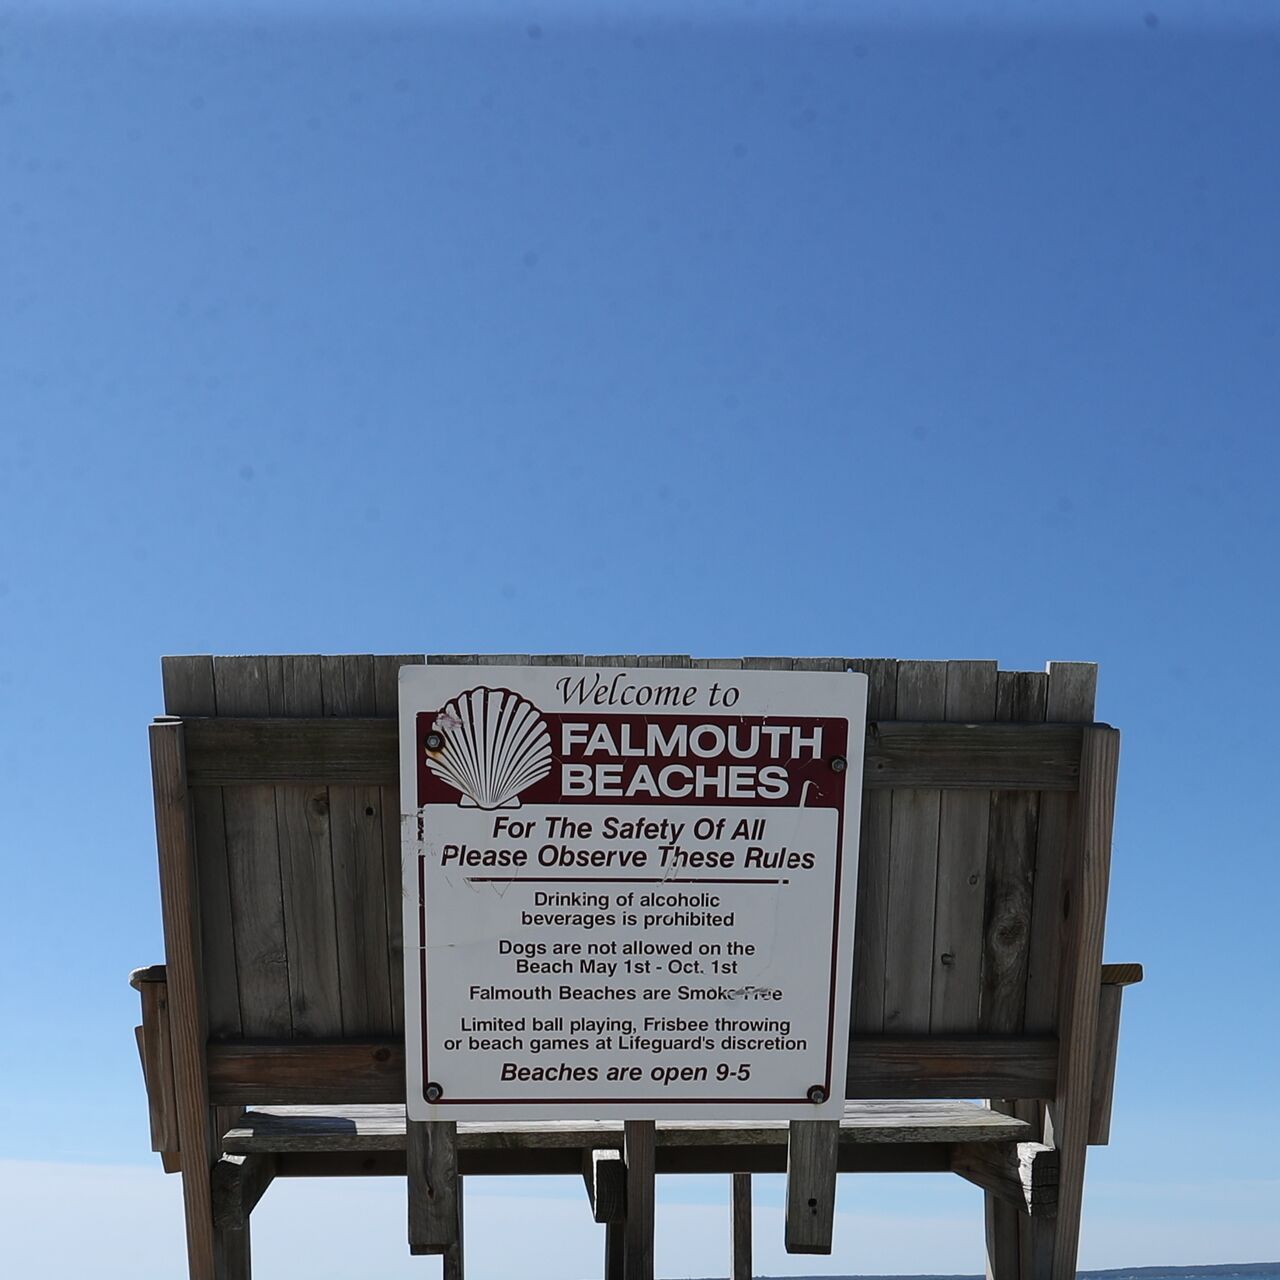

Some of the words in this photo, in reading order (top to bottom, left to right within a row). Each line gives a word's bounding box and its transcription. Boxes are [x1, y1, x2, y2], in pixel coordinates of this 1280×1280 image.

[556, 673, 697, 706] Welcome
[710, 683, 739, 707] to
[562, 723, 822, 759] FALMOUTH
[562, 764, 788, 799] BEACHES
[493, 817, 536, 838] For
[546, 817, 592, 839] The
[602, 817, 685, 845] Safety
[694, 818, 726, 840] Of
[731, 819, 766, 840] All
[441, 845, 527, 866] Please
[538, 845, 647, 867] Observe
[658, 846, 734, 868] These
[744, 847, 815, 869] Rules
[535, 892, 608, 910] Drinking
[616, 892, 633, 906] of
[640, 893, 719, 907] alcoholic
[522, 911, 615, 929] beverages
[623, 911, 637, 925] is
[645, 912, 734, 929] prohibited
[500, 940, 546, 958] Dogs
[553, 944, 581, 954] are
[588, 941, 616, 954] not
[623, 941, 692, 955] allowed
[699, 945, 720, 955] on
[727, 942, 755, 955] the
[517, 959, 572, 973] Beach
[580, 960, 617, 977] May
[624, 960, 650, 973] 1st
[669, 960, 703, 973] Oct.
[712, 960, 737, 974] 1st
[470, 986, 551, 1000] Falmouth
[560, 986, 636, 999] Beaches
[643, 989, 670, 1000] are
[462, 1018, 525, 1031] Limited
[533, 1018, 562, 1031] ball
[571, 1017, 640, 1035] playing,
[645, 1017, 708, 1031] Frisbee
[715, 1018, 790, 1036] throwing
[444, 1040, 462, 1050] or
[469, 1036, 522, 1050] beach
[530, 1039, 589, 1053] games
[596, 1036, 612, 1049] at
[619, 1036, 714, 1053] Lifeguard's
[721, 1036, 806, 1050] discretion
[501, 1063, 598, 1081] Beaches
[607, 1067, 642, 1081] are
[651, 1067, 707, 1085] open
[716, 1064, 750, 1081] 9-5
